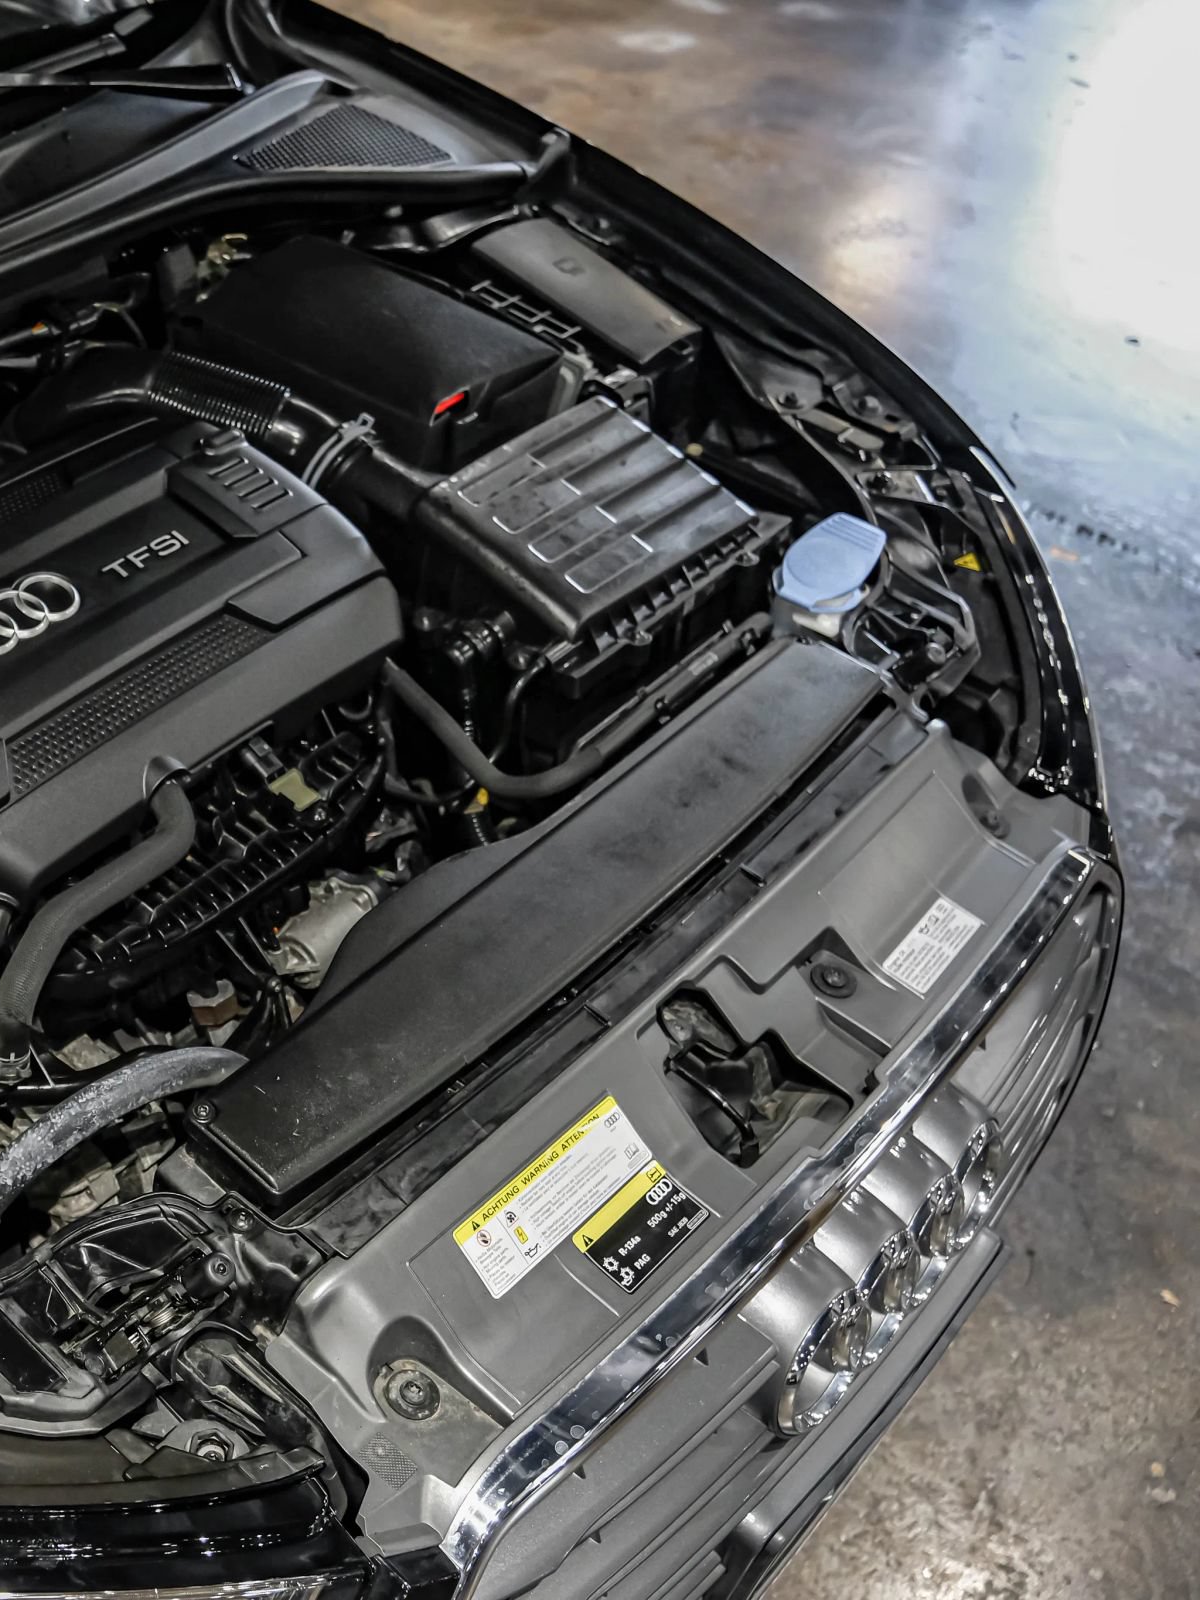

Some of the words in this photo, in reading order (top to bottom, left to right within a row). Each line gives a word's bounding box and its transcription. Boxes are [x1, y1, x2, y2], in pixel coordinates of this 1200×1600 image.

[101, 530, 190, 578] TFSI
[482, 1185, 520, 1222] ACHTUNG
[521, 1149, 560, 1186] WARNING
[561, 1113, 600, 1151] ATTENON
[647, 1210, 668, 1228] 500g
[667, 1226, 680, 1238] SAE
[618, 1235, 642, 1256] R-134a
[633, 1253, 651, 1270] PAG
